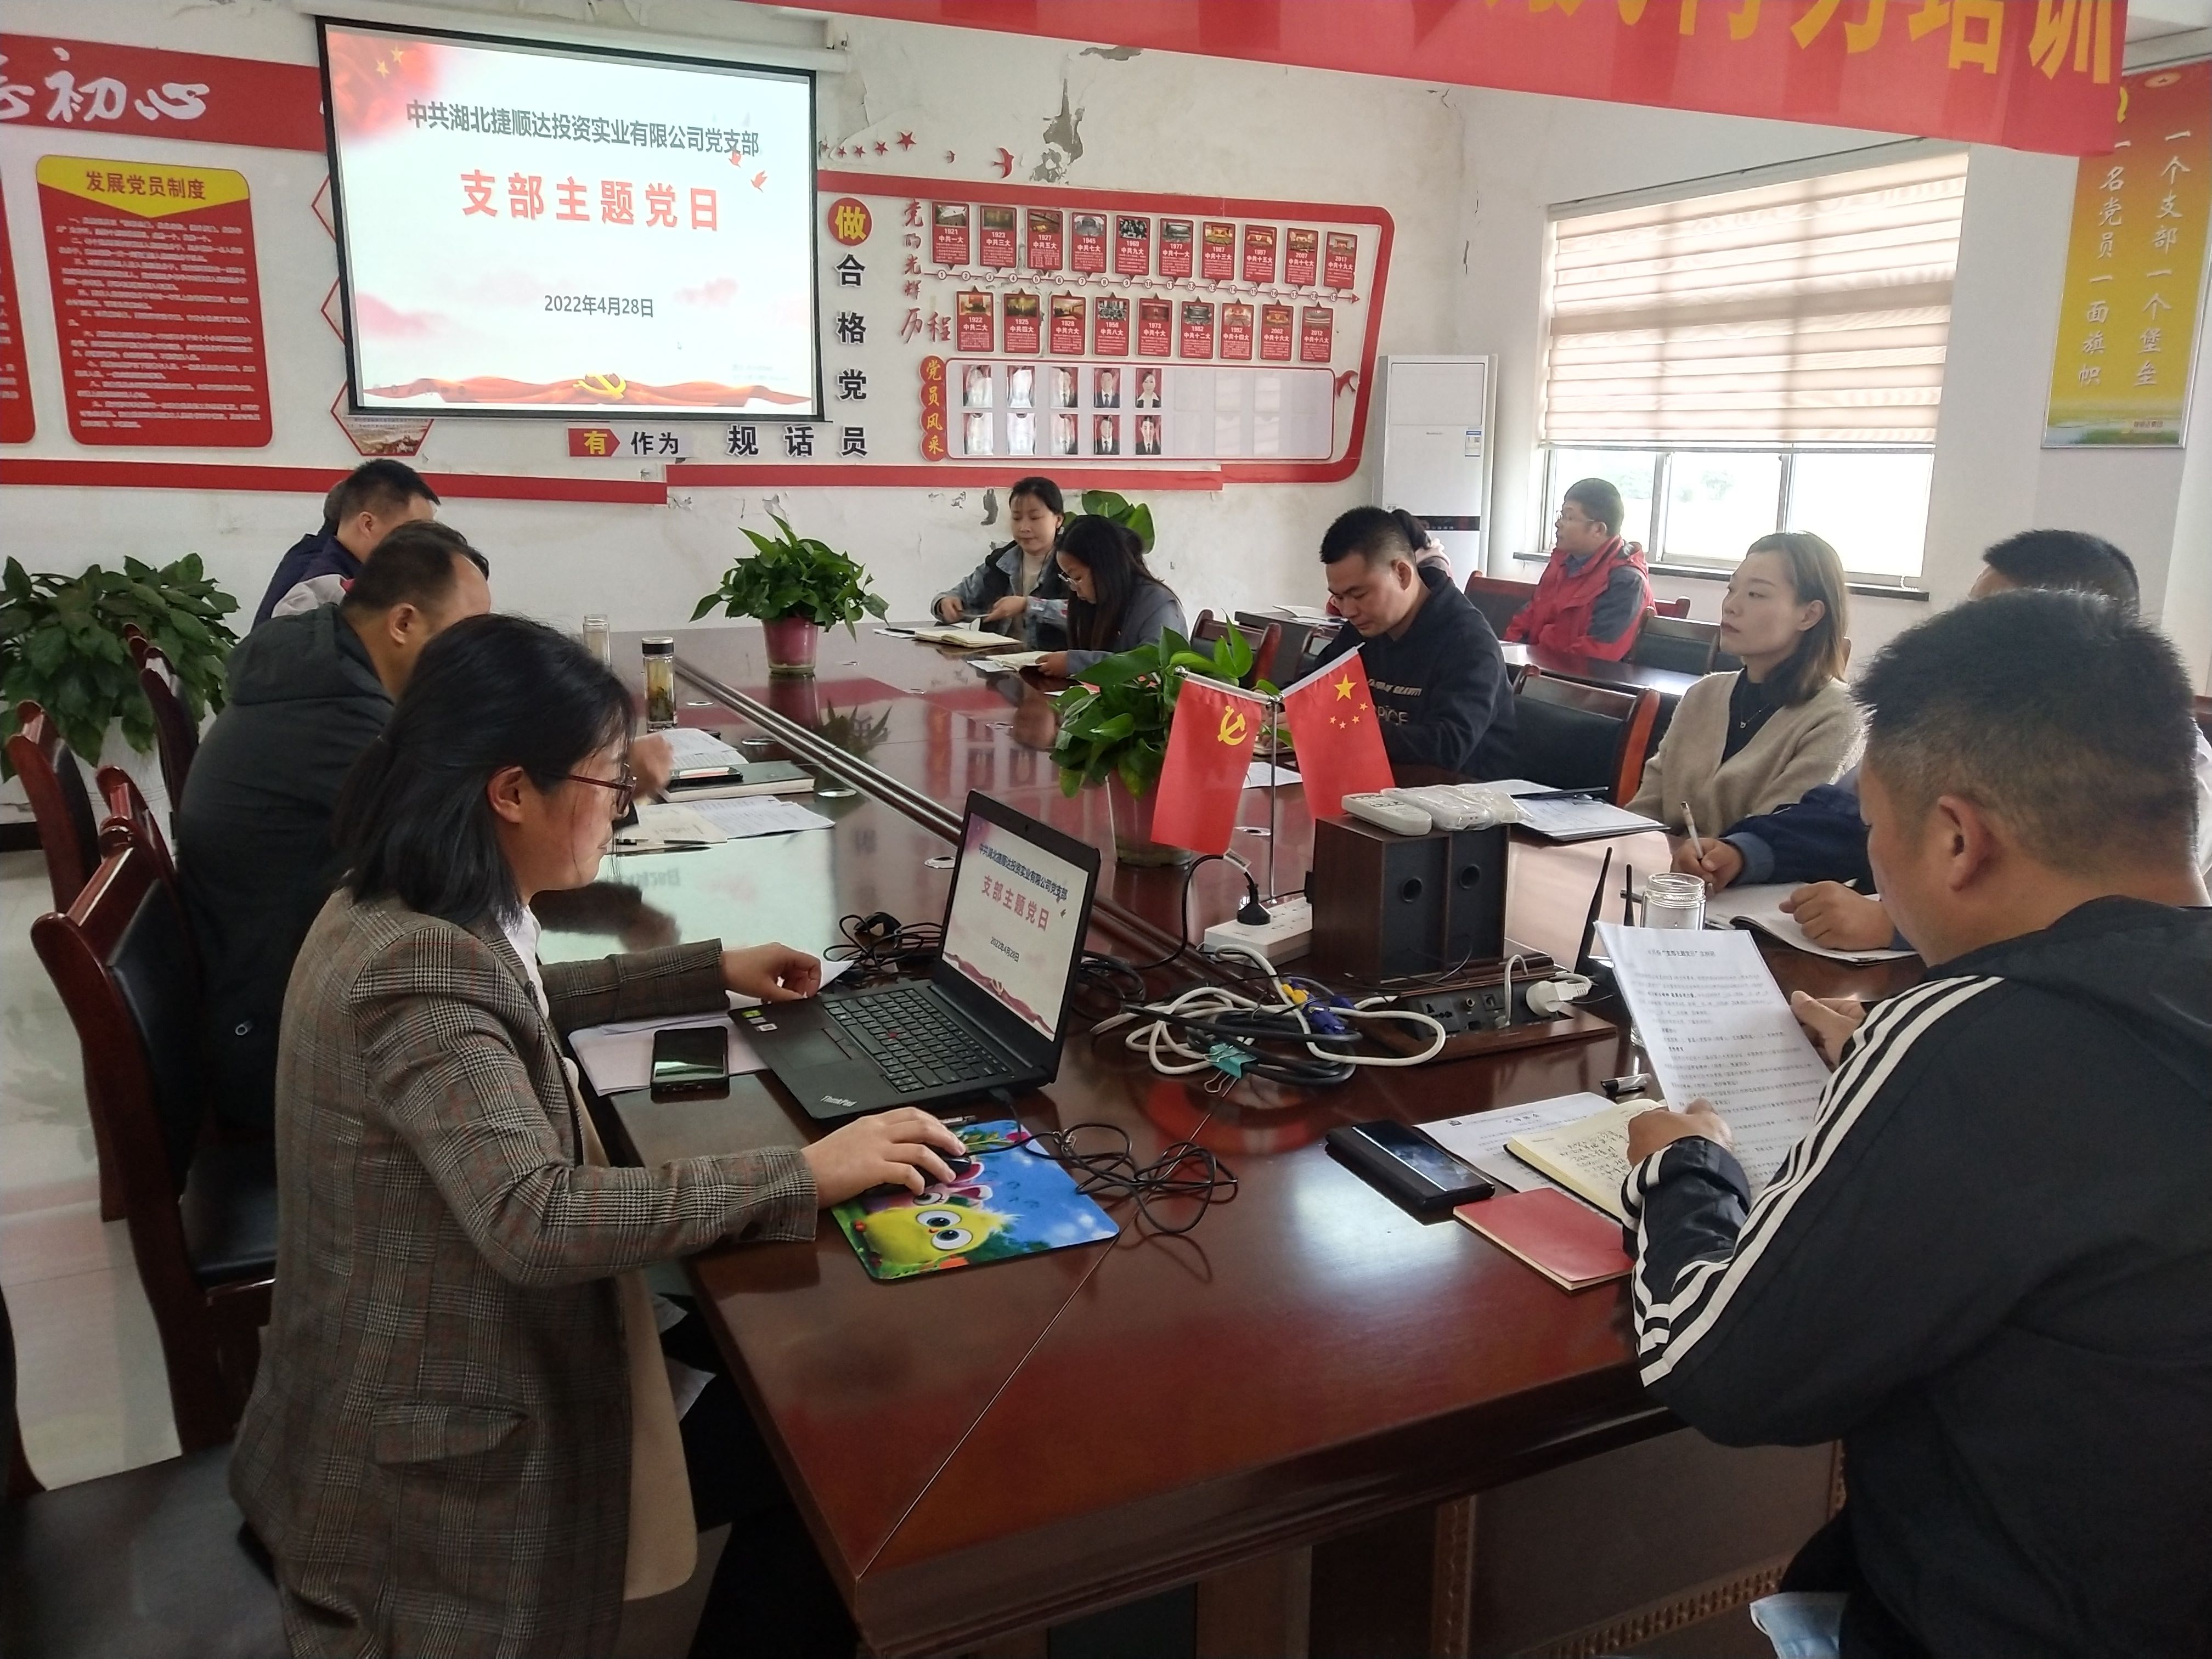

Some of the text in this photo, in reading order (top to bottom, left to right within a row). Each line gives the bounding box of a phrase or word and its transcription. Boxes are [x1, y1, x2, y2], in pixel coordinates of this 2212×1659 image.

[407, 100, 760, 156] 中共湖北捷顺达投资实业有限公司党支部
[86, 171, 206, 200] 发展党员制度
[460, 169, 719, 232] 支部主题党日
[2134, 131, 2191, 387] 一个支部一个堡垒
[544, 294, 654, 318] 2022年4月28日
[835, 205, 868, 456] 做合格党员
[926, 359, 944, 455] 党员风采
[729, 426, 758, 455] 规
[785, 426, 813, 456] 话
[981, 876, 1049, 932] 支部主题党日
